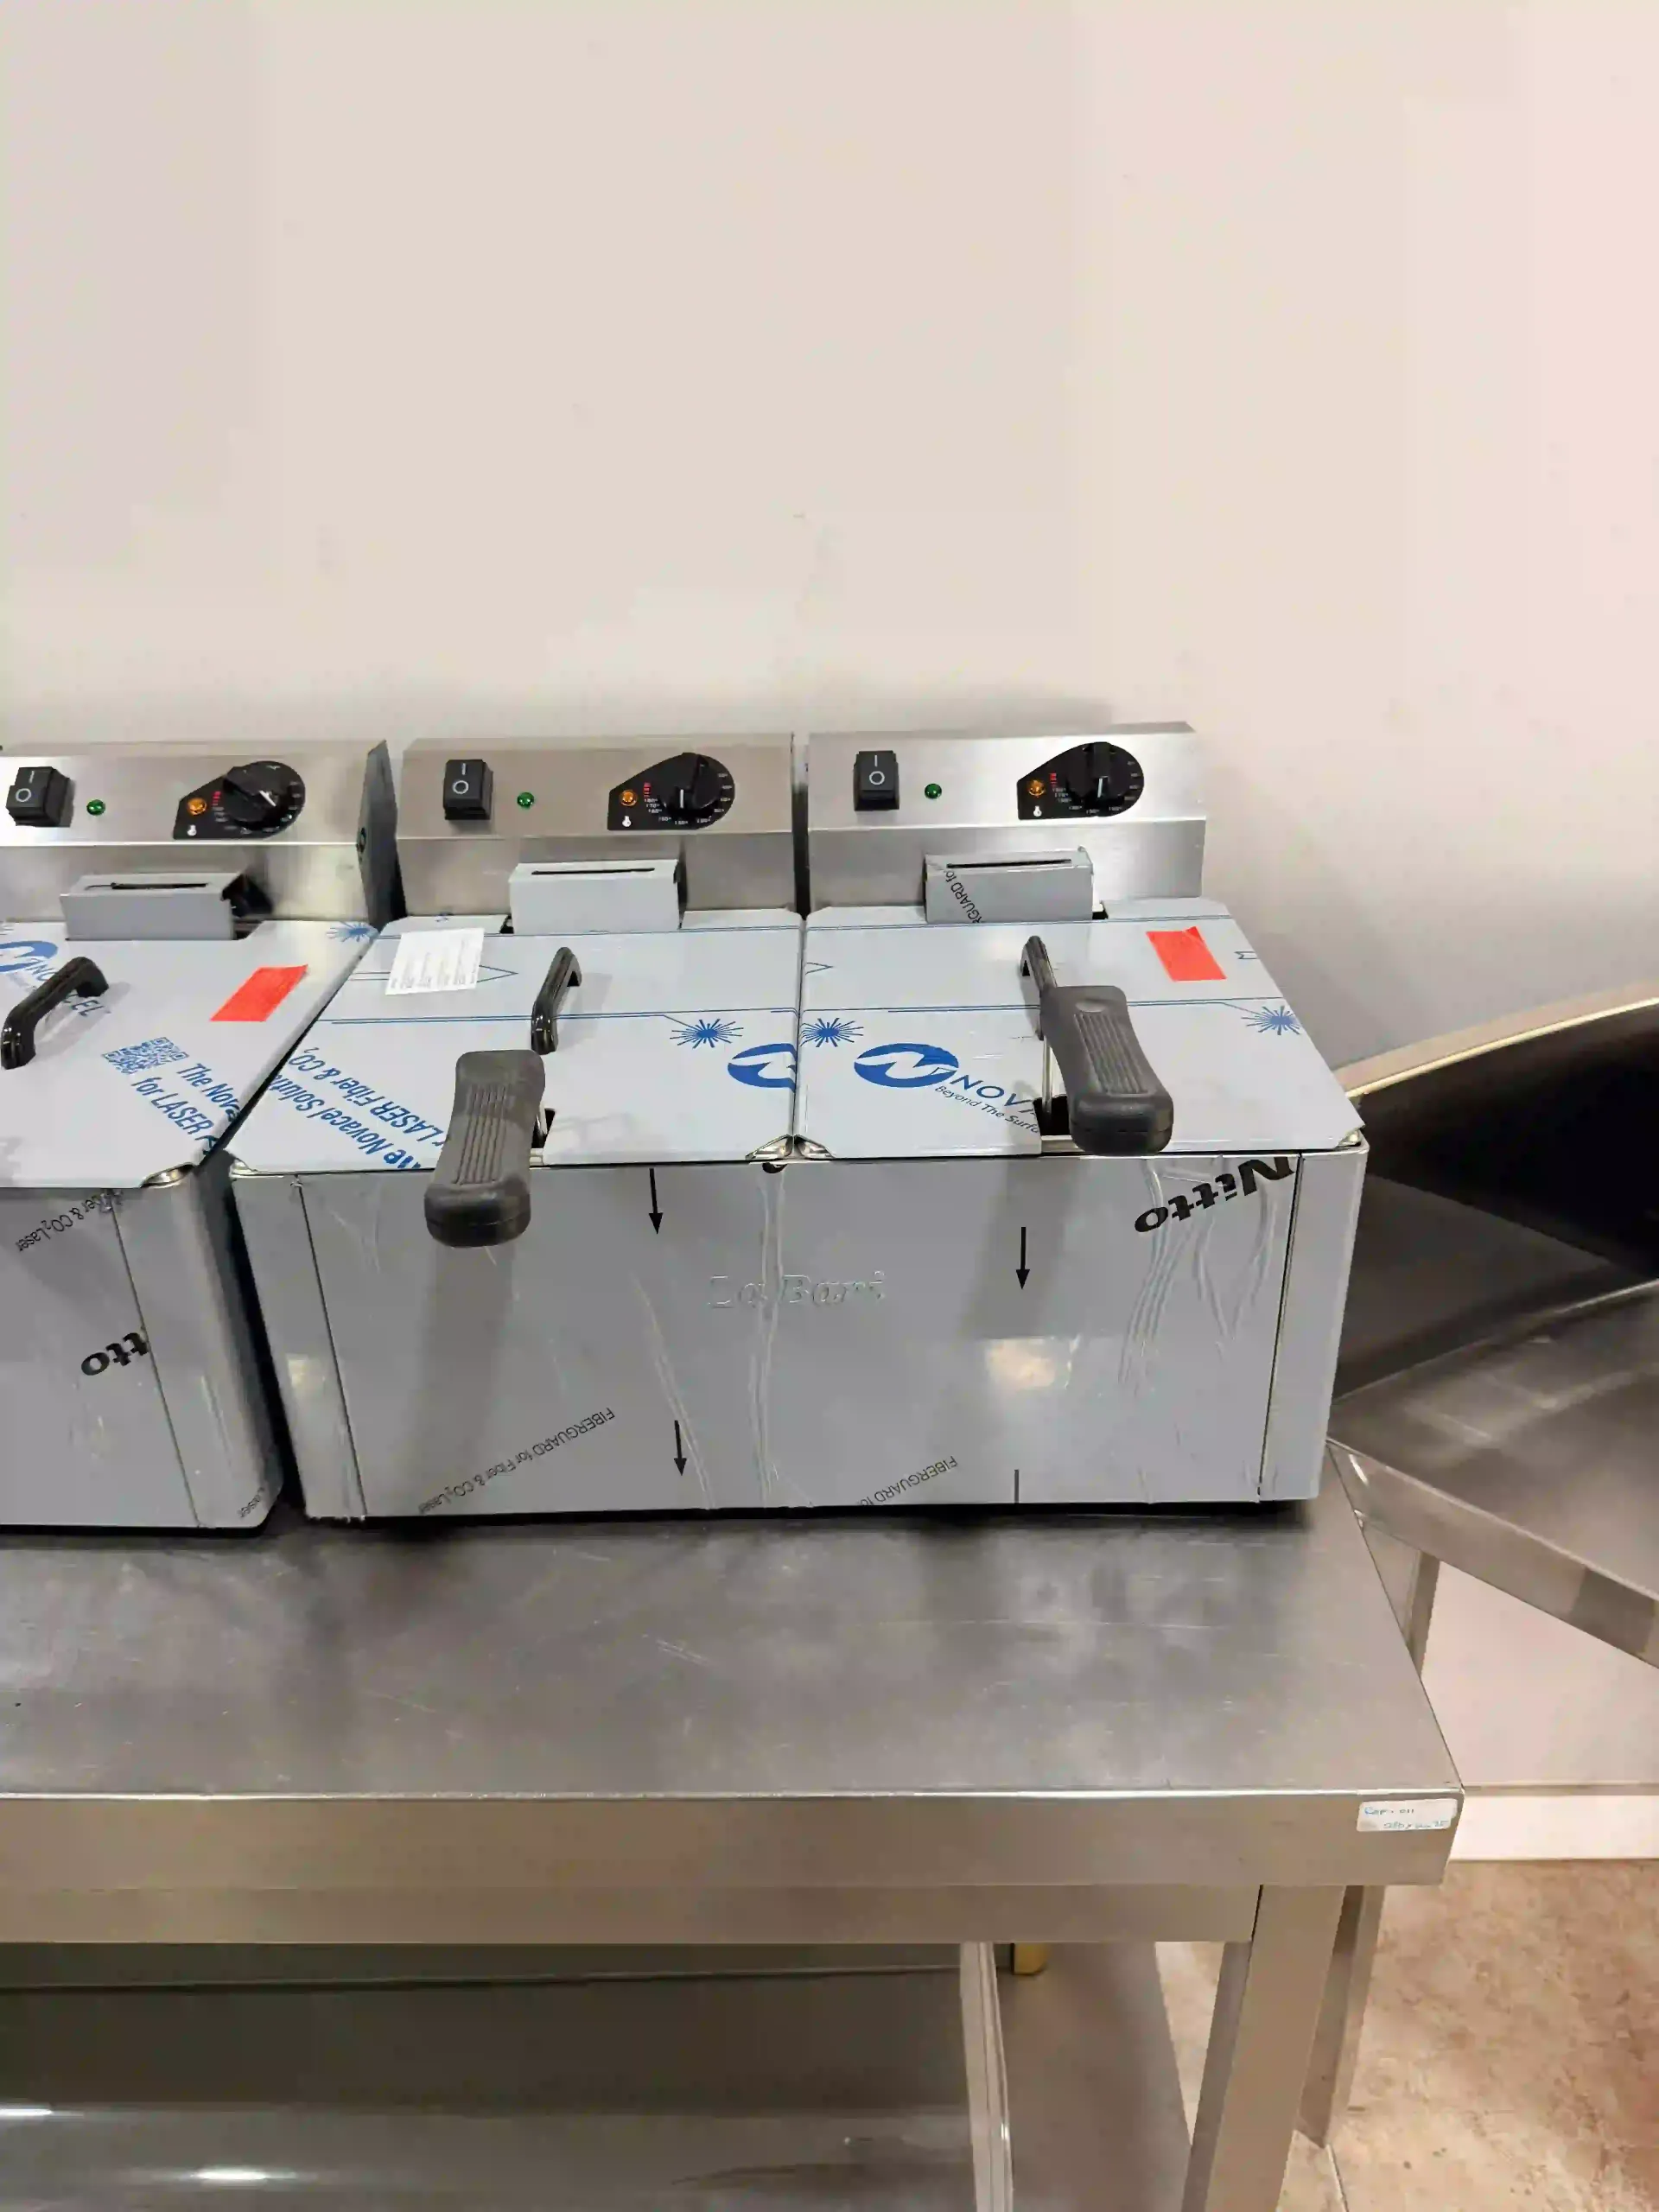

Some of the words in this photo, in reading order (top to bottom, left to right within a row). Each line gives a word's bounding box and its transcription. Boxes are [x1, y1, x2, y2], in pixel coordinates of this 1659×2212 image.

[944, 869, 957, 882] fo
[176, 1063, 213, 1087] The
[312, 1066, 341, 1081] &
[130, 1076, 165, 1096] for
[150, 1092, 215, 1135] LASER
[330, 1077, 385, 1107] Fiber
[934, 1084, 983, 1109] Beyond
[983, 1103, 1006, 1118] The
[306, 1106, 395, 1155] Novacel
[369, 1101, 444, 1142] LASER
[1134, 1156, 1295, 1233] Nitto
[69, 1207, 85, 1220] &
[532, 1407, 616, 1456] FIBERGUARD
[485, 1459, 518, 1479] Fiber
[514, 1449, 533, 1464] for
[874, 1455, 958, 1503] FIBERGUARD
